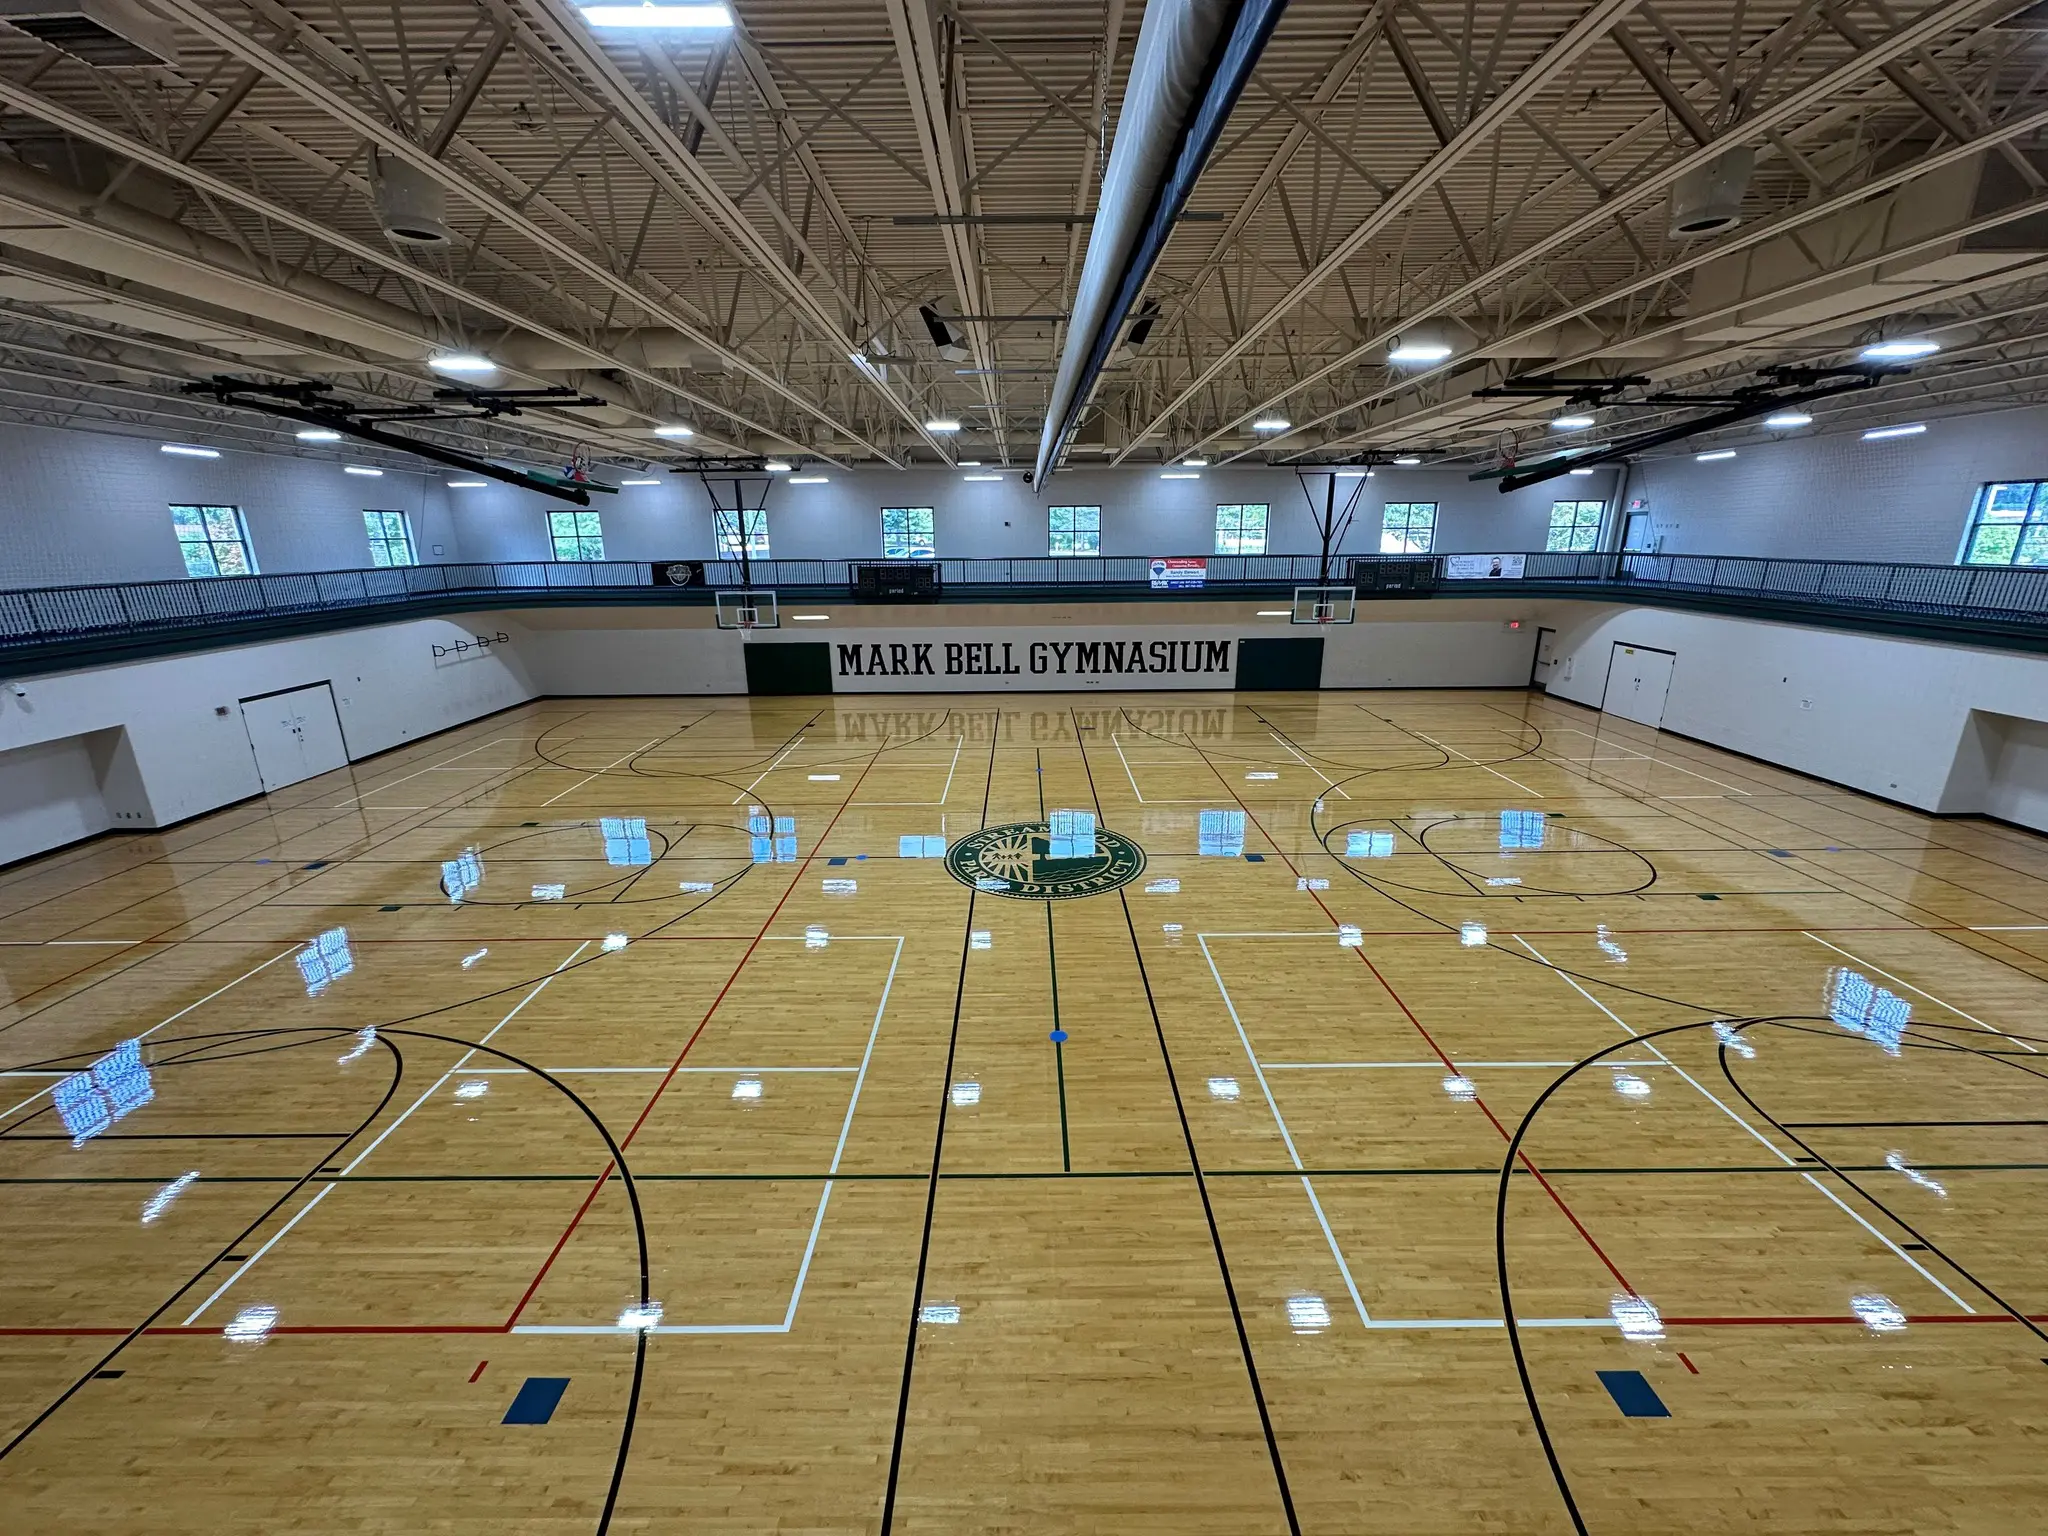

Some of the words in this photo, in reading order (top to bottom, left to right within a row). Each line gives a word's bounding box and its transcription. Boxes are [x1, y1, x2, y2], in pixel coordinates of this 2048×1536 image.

[837, 643, 936, 676] MARK
[944, 642, 1021, 675] BELL
[1029, 640, 1232, 674] GYMNASIUM
[966, 825, 1121, 850] STREAMOD
[1020, 858, 1133, 894] DISTRICT
